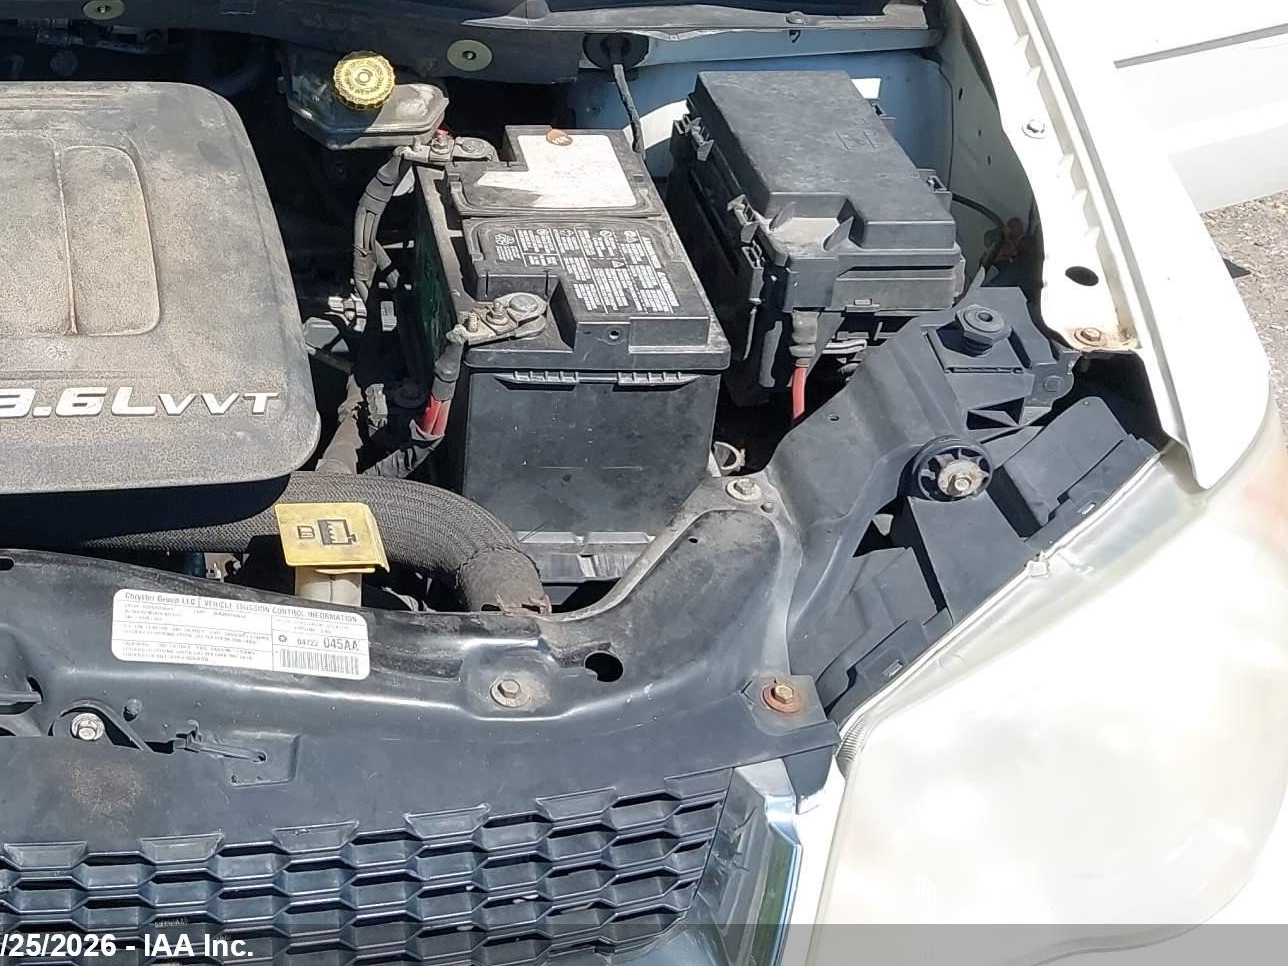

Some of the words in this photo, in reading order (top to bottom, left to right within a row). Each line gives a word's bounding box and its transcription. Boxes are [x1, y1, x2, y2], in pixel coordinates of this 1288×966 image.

[158, 392, 280, 417] VVT
[125, 592, 155, 602] Chrysler
[157, 595, 180, 605] Group
[204, 600, 233, 609] VEHICLE
[236, 603, 270, 613] EMISSION
[272, 606, 305, 616] CONTROL
[307, 612, 358, 623] INFORMATION
[323, 637, 359, 651] 045AA
